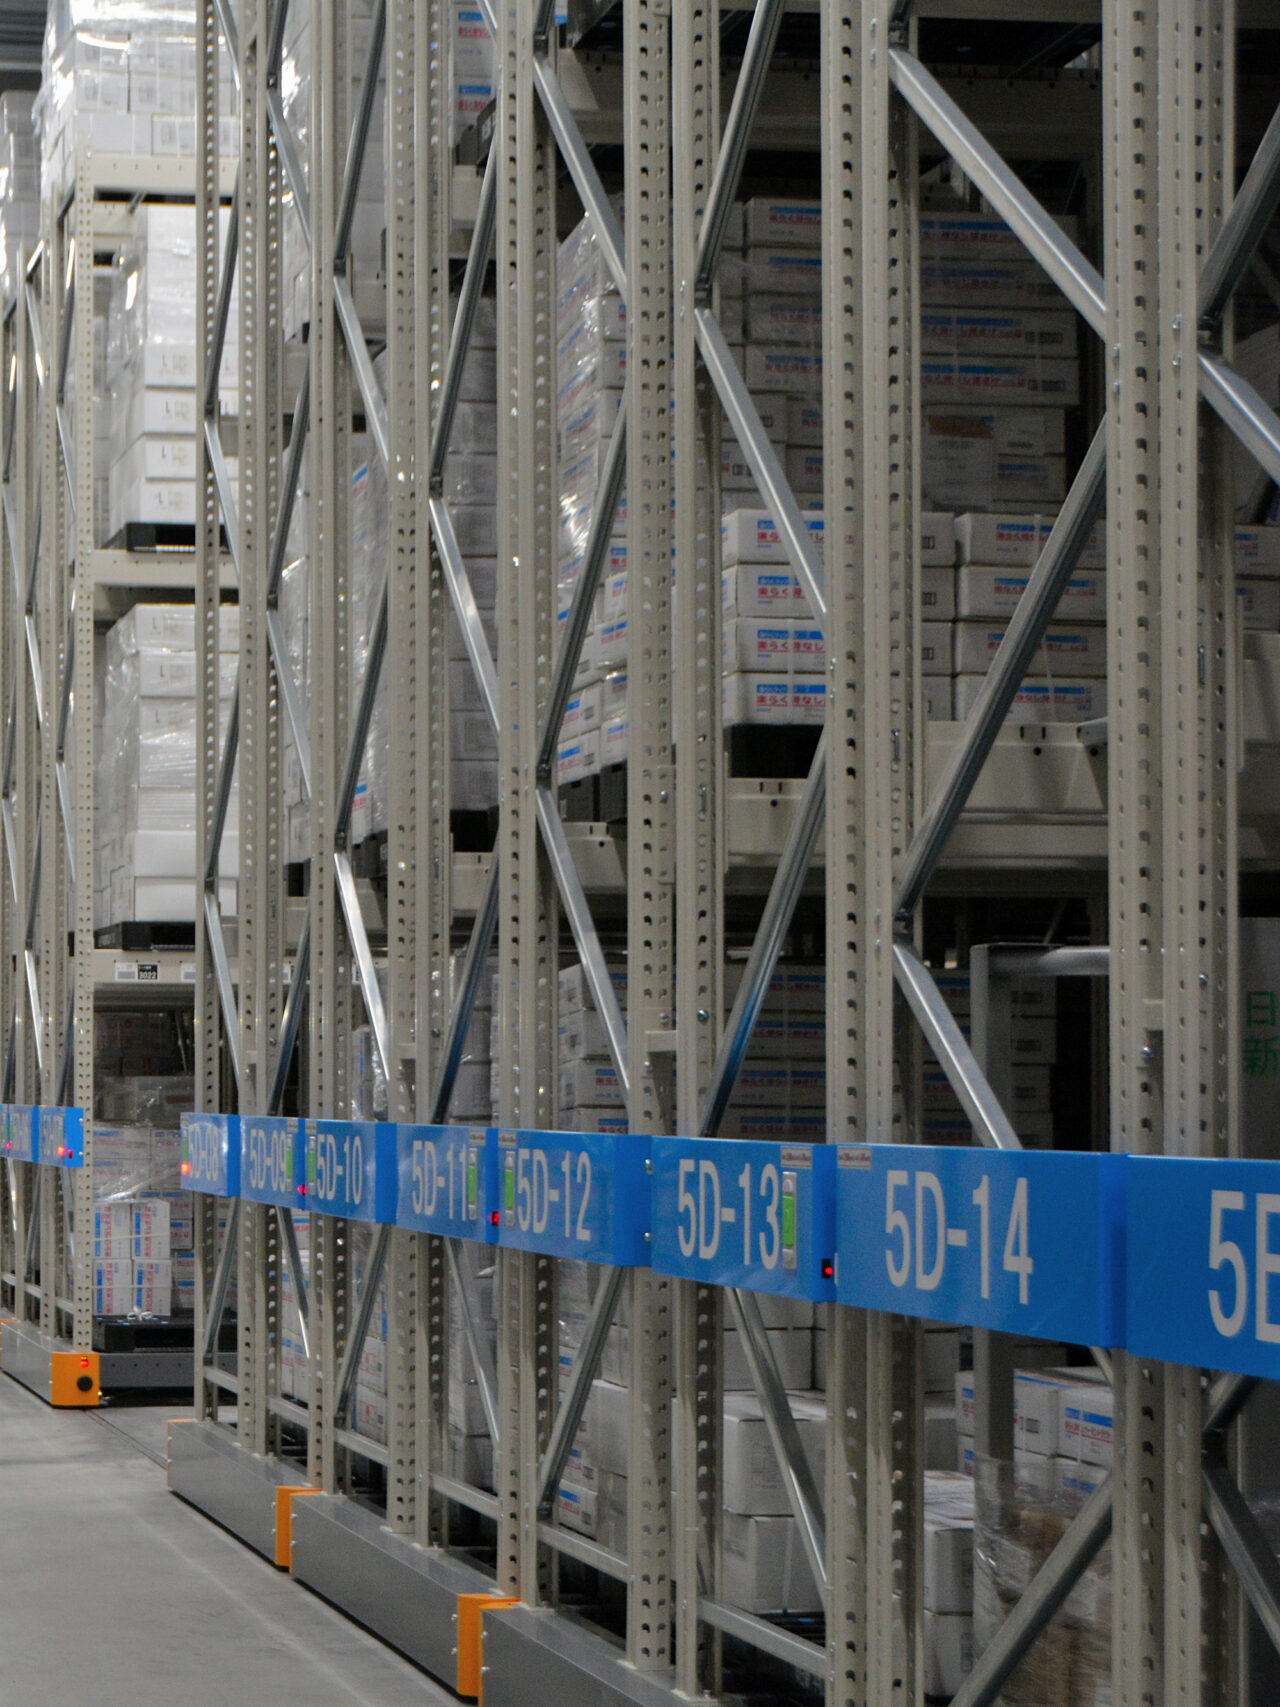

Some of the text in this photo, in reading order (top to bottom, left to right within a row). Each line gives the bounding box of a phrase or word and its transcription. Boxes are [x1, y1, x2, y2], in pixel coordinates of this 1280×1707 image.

[249, 1129, 287, 1193] 5D-09
[316, 1133, 363, 1205] 5D-10
[412, 1140, 467, 1221] 5D-11
[518, 1148, 592, 1241] 5D-12
[677, 1158, 779, 1271] 5D-13
[885, 1169, 1035, 1305] 5D-14
